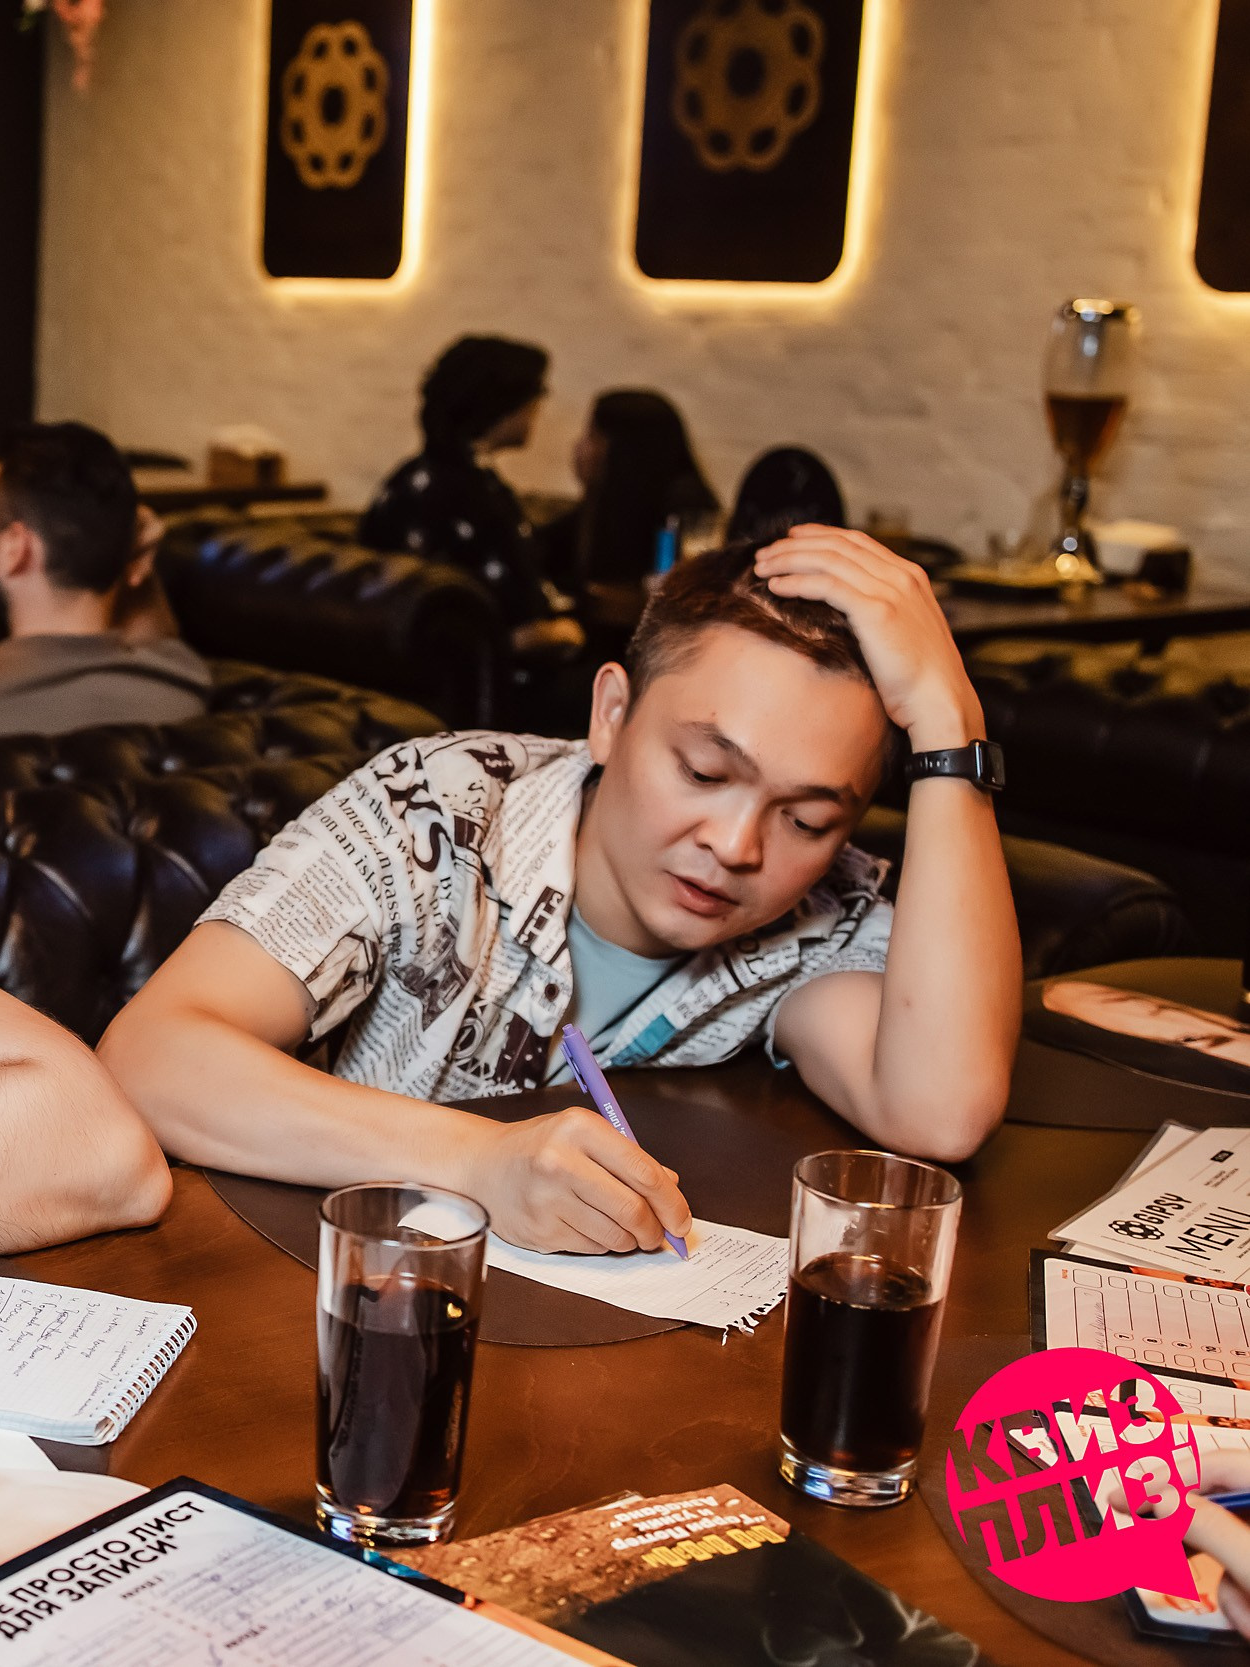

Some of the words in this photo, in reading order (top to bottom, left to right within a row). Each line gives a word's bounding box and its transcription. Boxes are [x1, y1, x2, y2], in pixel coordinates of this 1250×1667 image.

[320, 816, 338, 832] on
[335, 834, 356, 856] an
[369, 798, 397, 838] they
[1133, 1192, 1192, 1226] GIPSY
[1165, 1206, 1250, 1261] MENU
[9, 1540, 131, 1603] ПРОСТО
[128, 1501, 204, 1541] ЛИСТ
